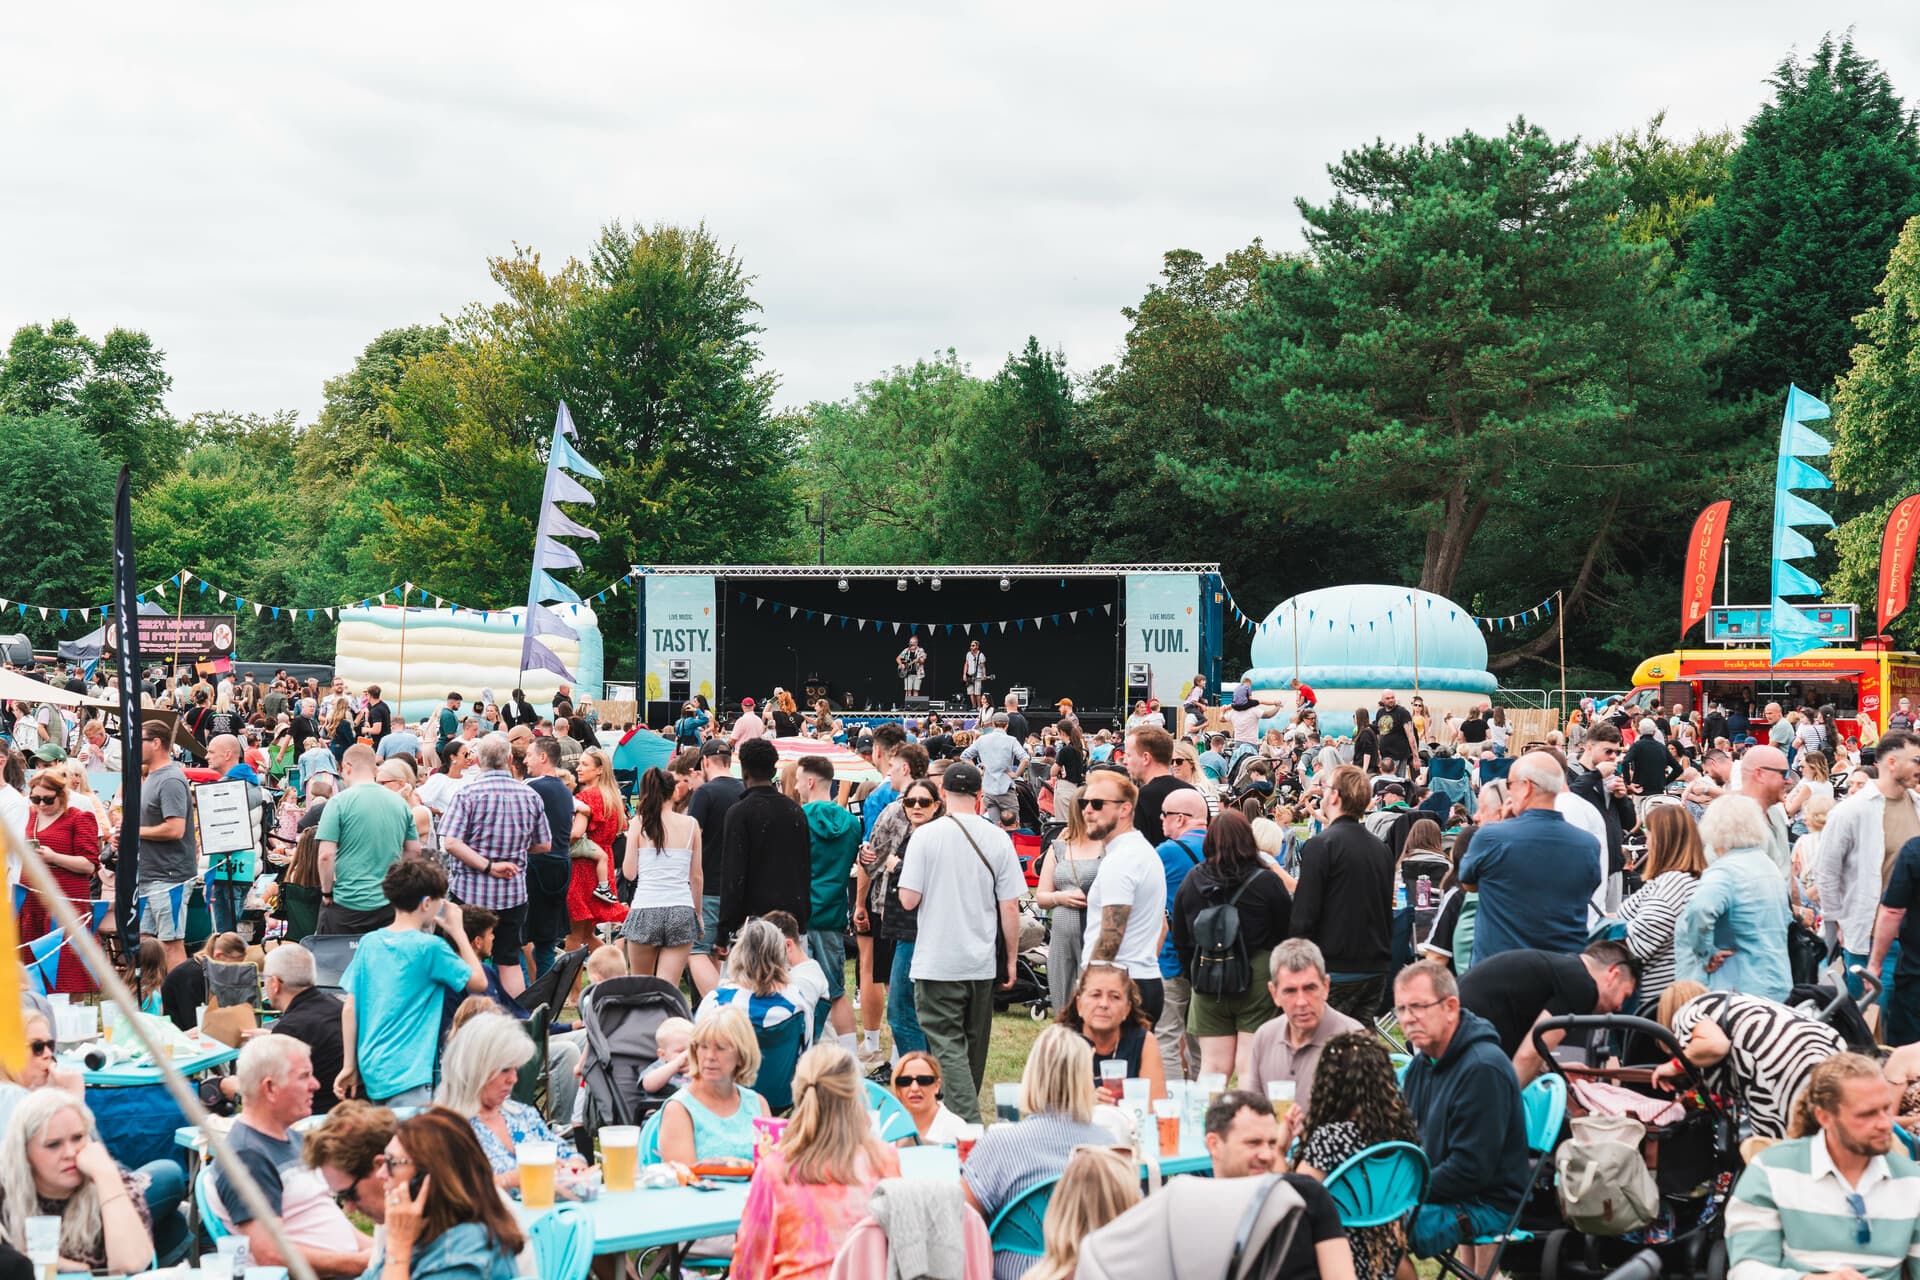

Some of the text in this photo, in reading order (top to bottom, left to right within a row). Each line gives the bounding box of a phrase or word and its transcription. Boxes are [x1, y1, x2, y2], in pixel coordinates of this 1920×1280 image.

[1695, 509, 1716, 598] CHURROS
[1890, 503, 1912, 593] COFFEE
[652, 628, 712, 652] TASTY.
[1141, 629, 1189, 653] YUM.
[1748, 660, 1767, 669] Made
[1801, 660, 1835, 669] Chocolate
